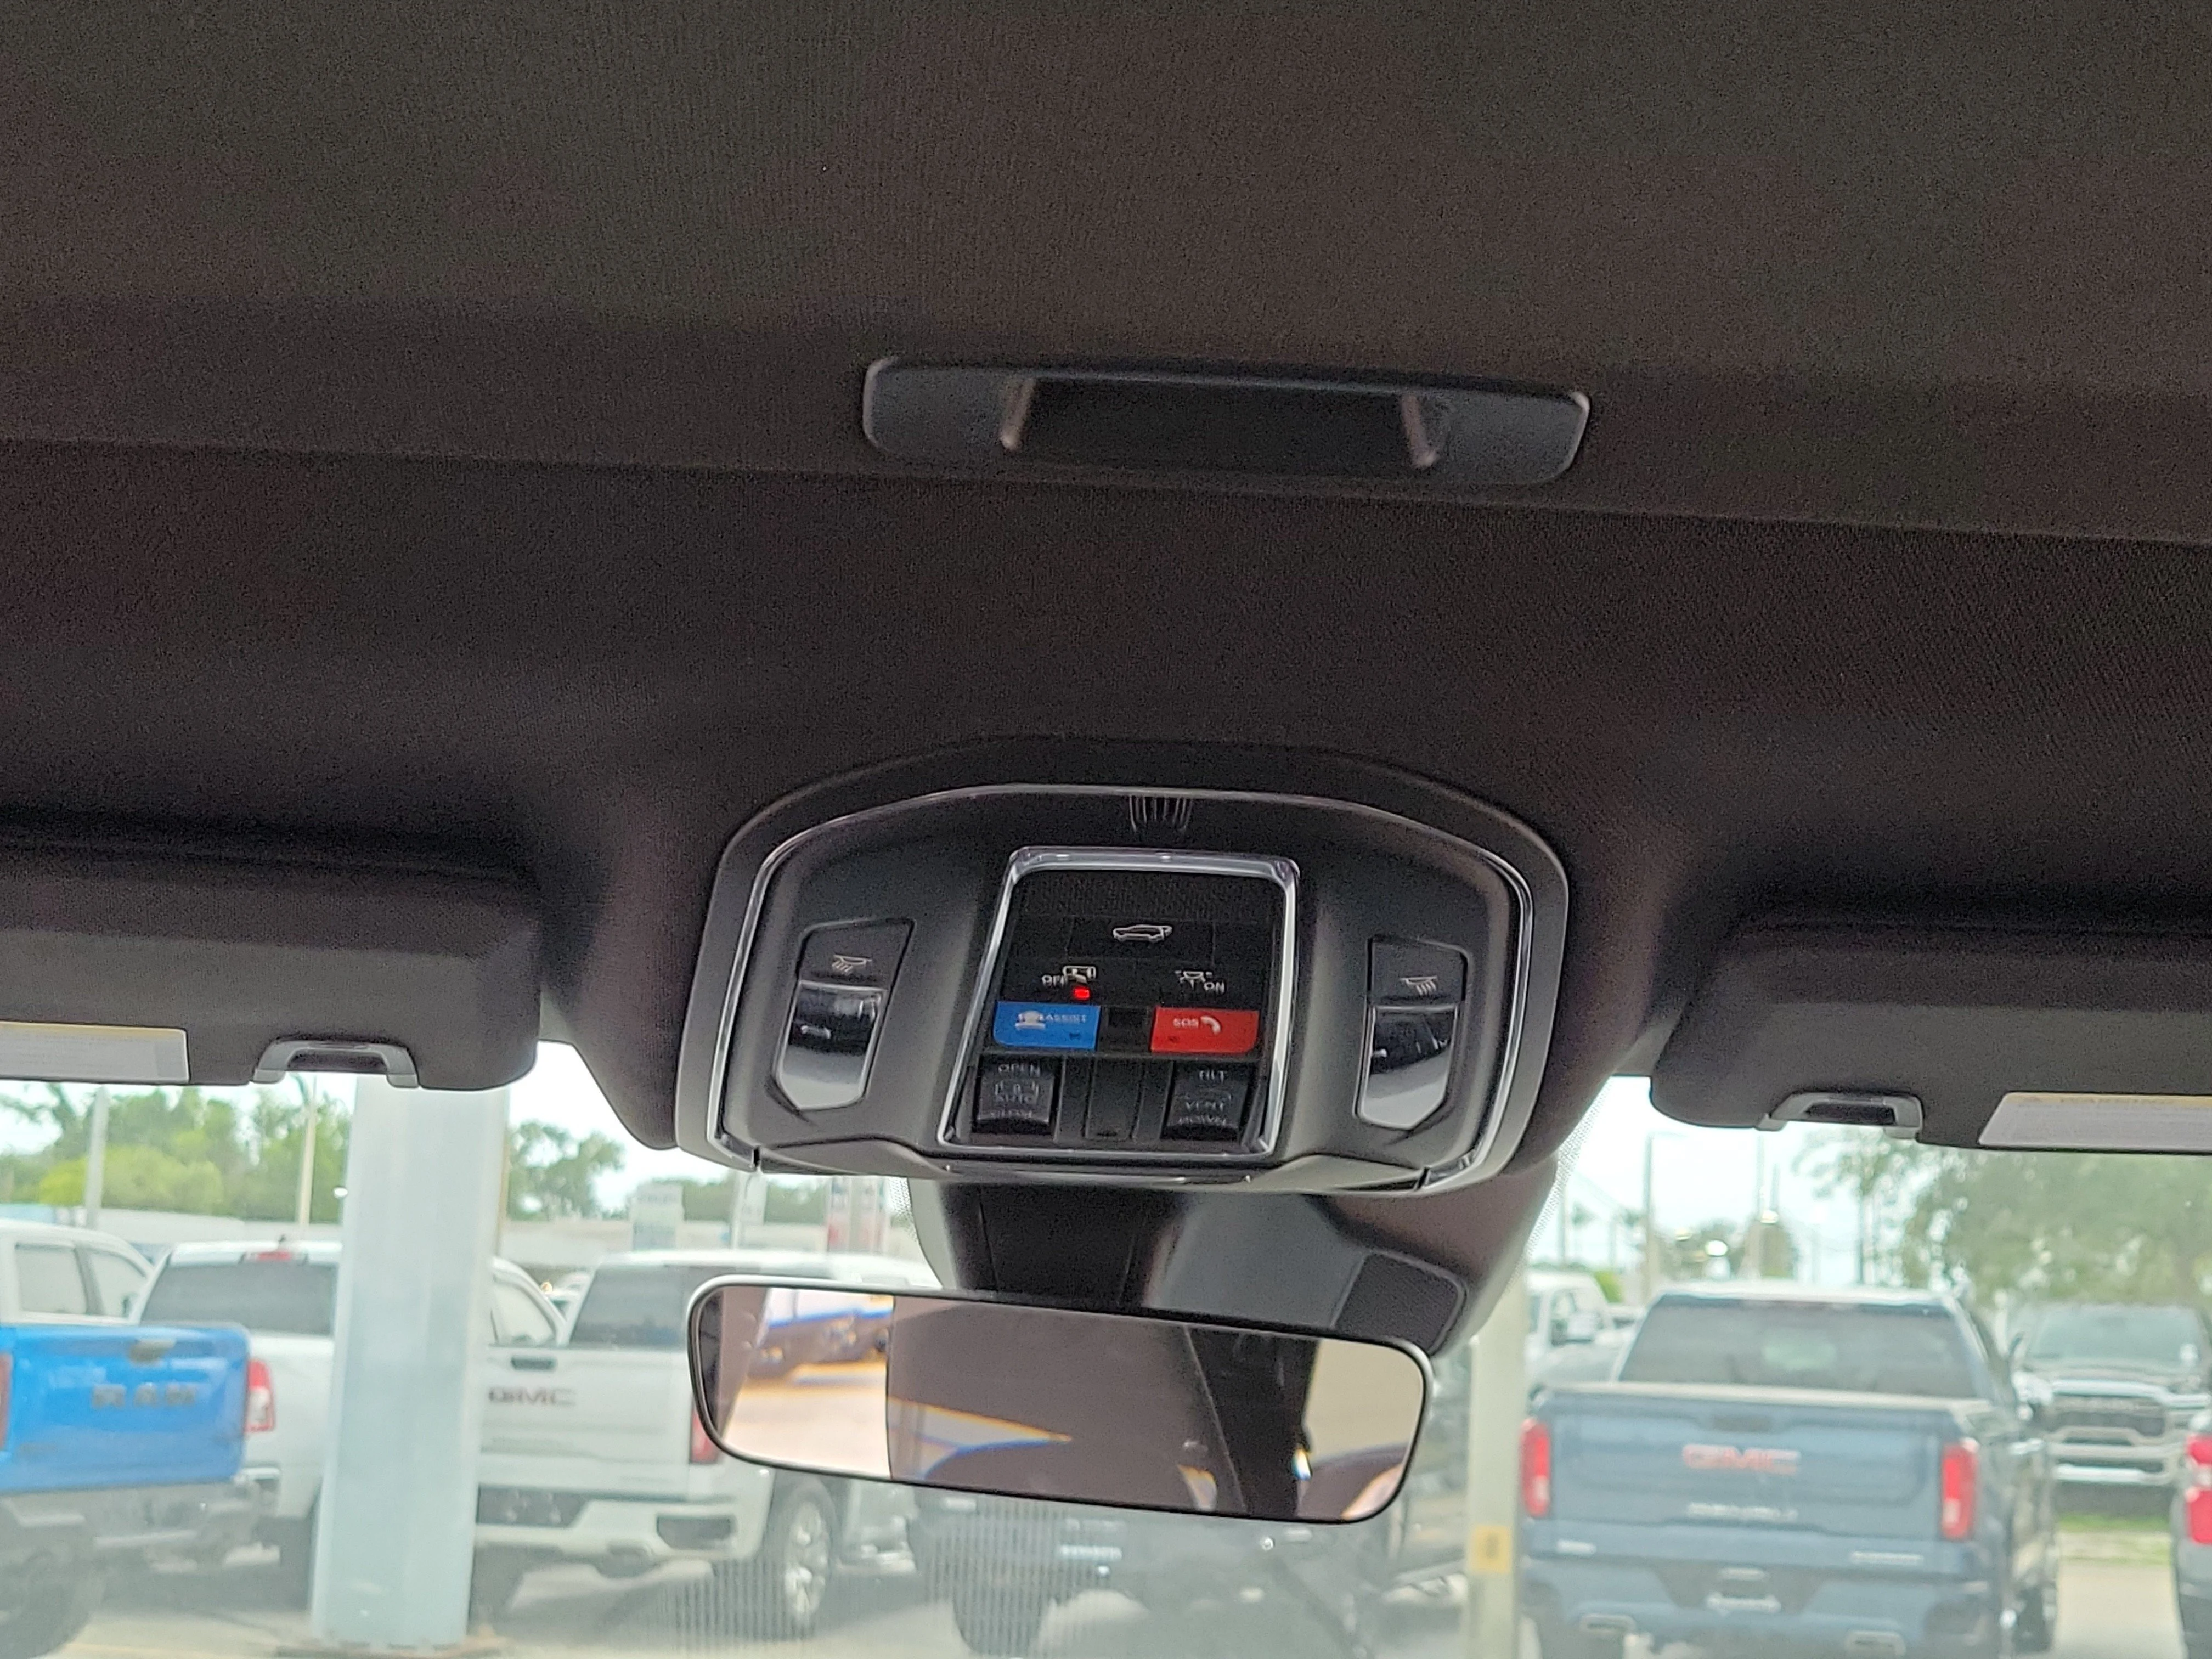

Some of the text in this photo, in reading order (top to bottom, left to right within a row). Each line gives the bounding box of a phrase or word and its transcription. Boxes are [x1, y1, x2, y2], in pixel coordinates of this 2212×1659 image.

[1204, 980, 1224, 994] ON
[1173, 1018, 1199, 1029] SOS
[489, 1386, 575, 1406] GMC
[1682, 1443, 1801, 1476] GMC
